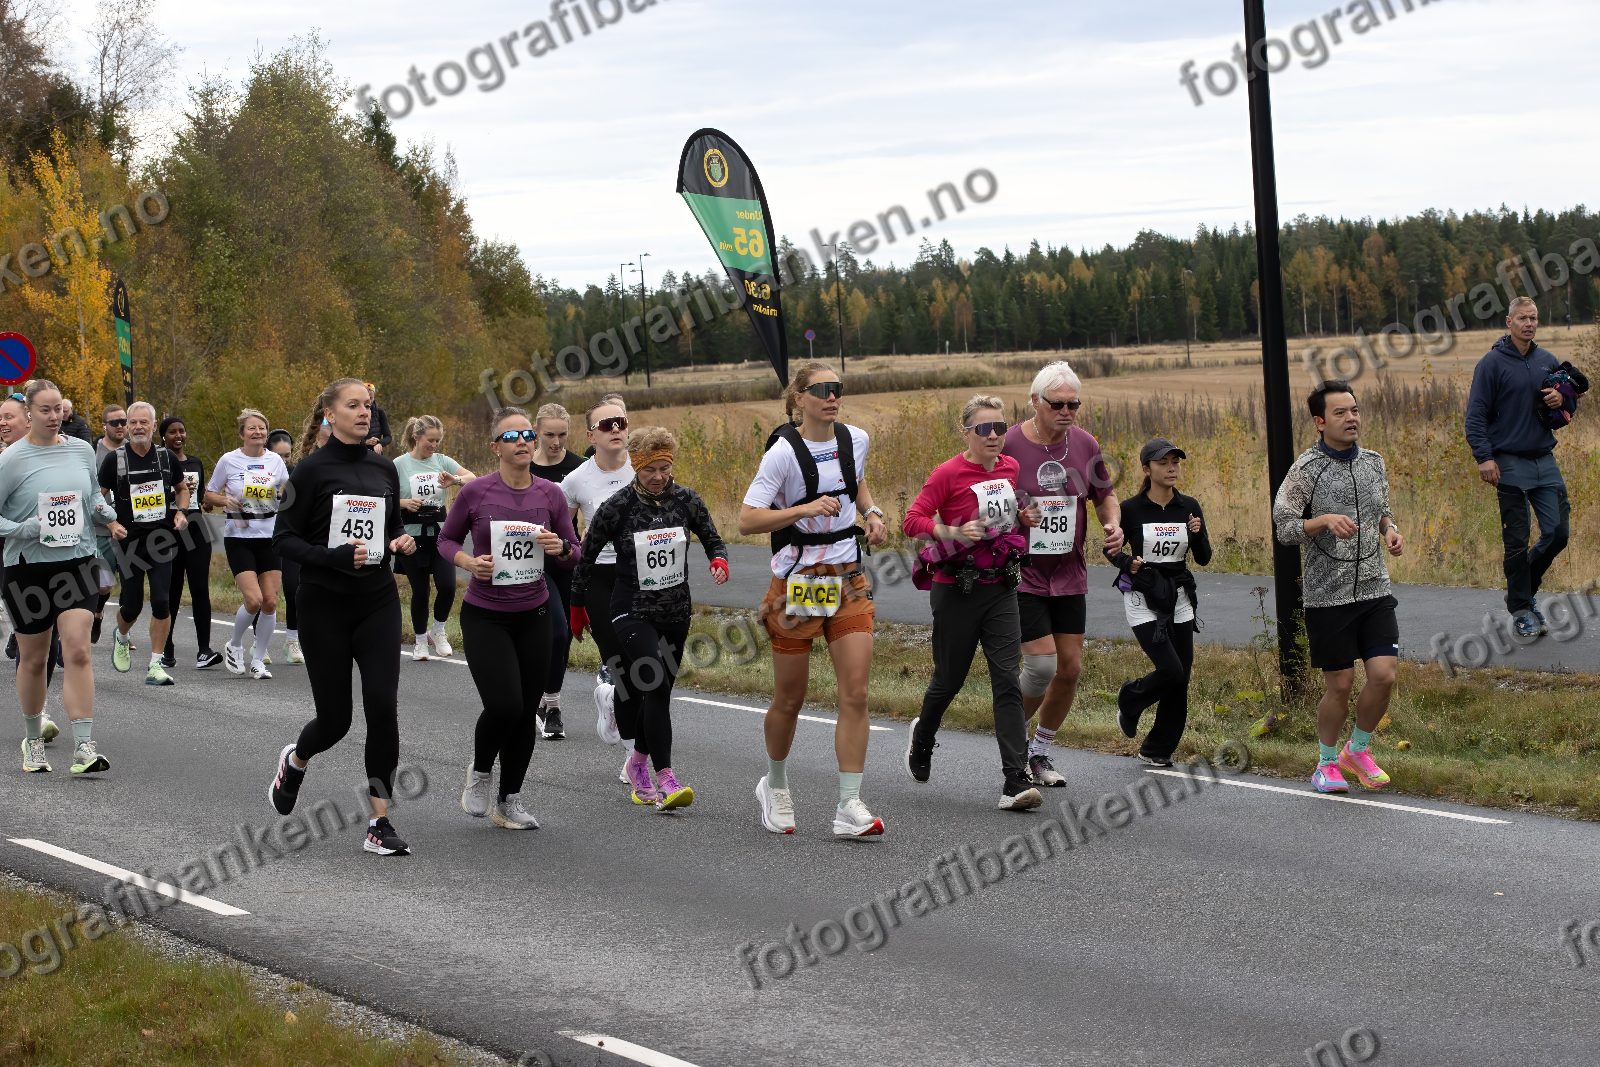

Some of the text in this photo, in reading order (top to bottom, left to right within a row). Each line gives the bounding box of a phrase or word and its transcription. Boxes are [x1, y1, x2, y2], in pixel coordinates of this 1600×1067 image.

[246, 487, 273, 499] PACE
[418, 484, 435, 496] 461
[135, 495, 163, 508] PACE
[345, 499, 377, 508] NORGES
[988, 499, 1011, 518] 614
[47, 509, 76, 527] 988
[1040, 515, 1068, 534] 458
[341, 518, 374, 540] 453
[647, 531, 677, 540] NORGES
[502, 541, 534, 560] 462
[1152, 540, 1180, 557] 467
[646, 548, 676, 569] 661
[793, 585, 837, 604] PACE
